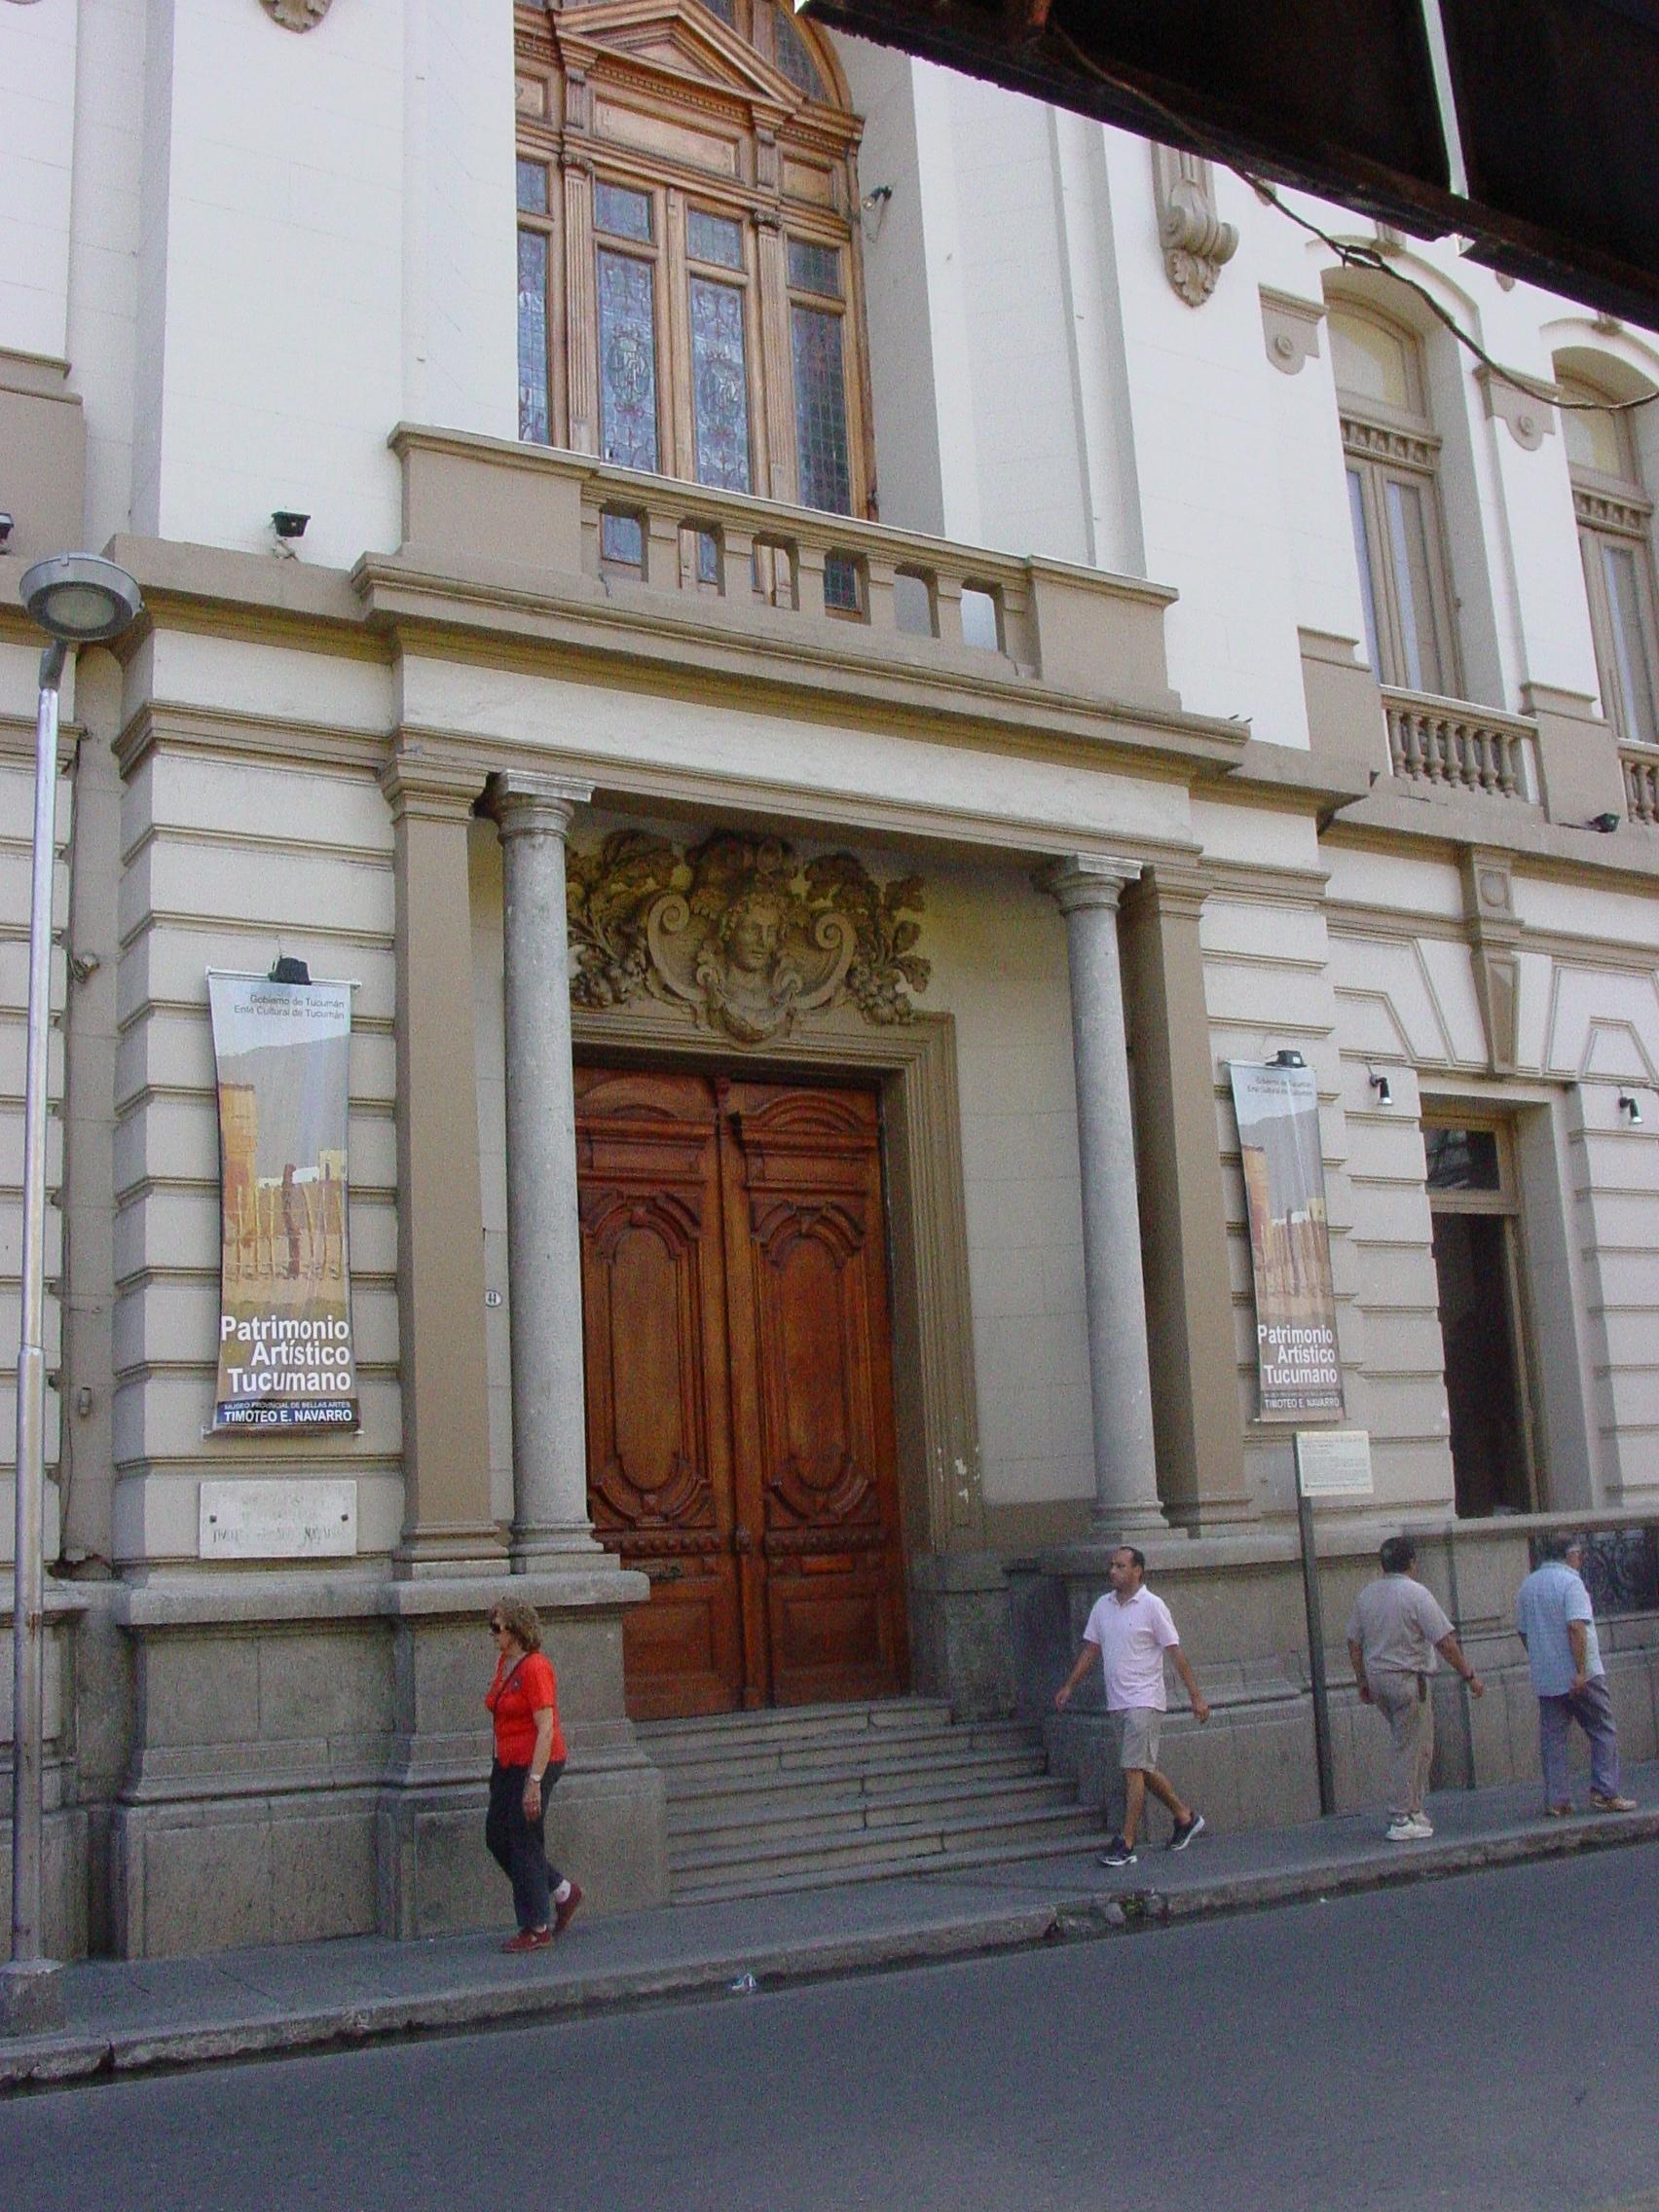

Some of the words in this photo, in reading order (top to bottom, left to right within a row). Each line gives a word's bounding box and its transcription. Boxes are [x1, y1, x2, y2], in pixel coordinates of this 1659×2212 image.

[234, 1005, 253, 1014] Ente
[256, 1006, 290, 1016] Cultural
[292, 1009, 303, 1017] de
[306, 1009, 345, 1019] Tucumán
[292, 997, 303, 1006] de
[306, 997, 345, 1008] Tucumán
[221, 1314, 350, 1341] Patrimonio
[1257, 1324, 1333, 1345] Patrimonio
[250, 1340, 350, 1366] Artístico
[1277, 1344, 1336, 1364] Artístico
[227, 1367, 351, 1393] Tucumano
[1263, 1364, 1338, 1384] Tucumano
[224, 1410, 277, 1422] TIMOTEO
[279, 1410, 292, 1422] E.
[294, 1409, 352, 1421] NAVARRO
